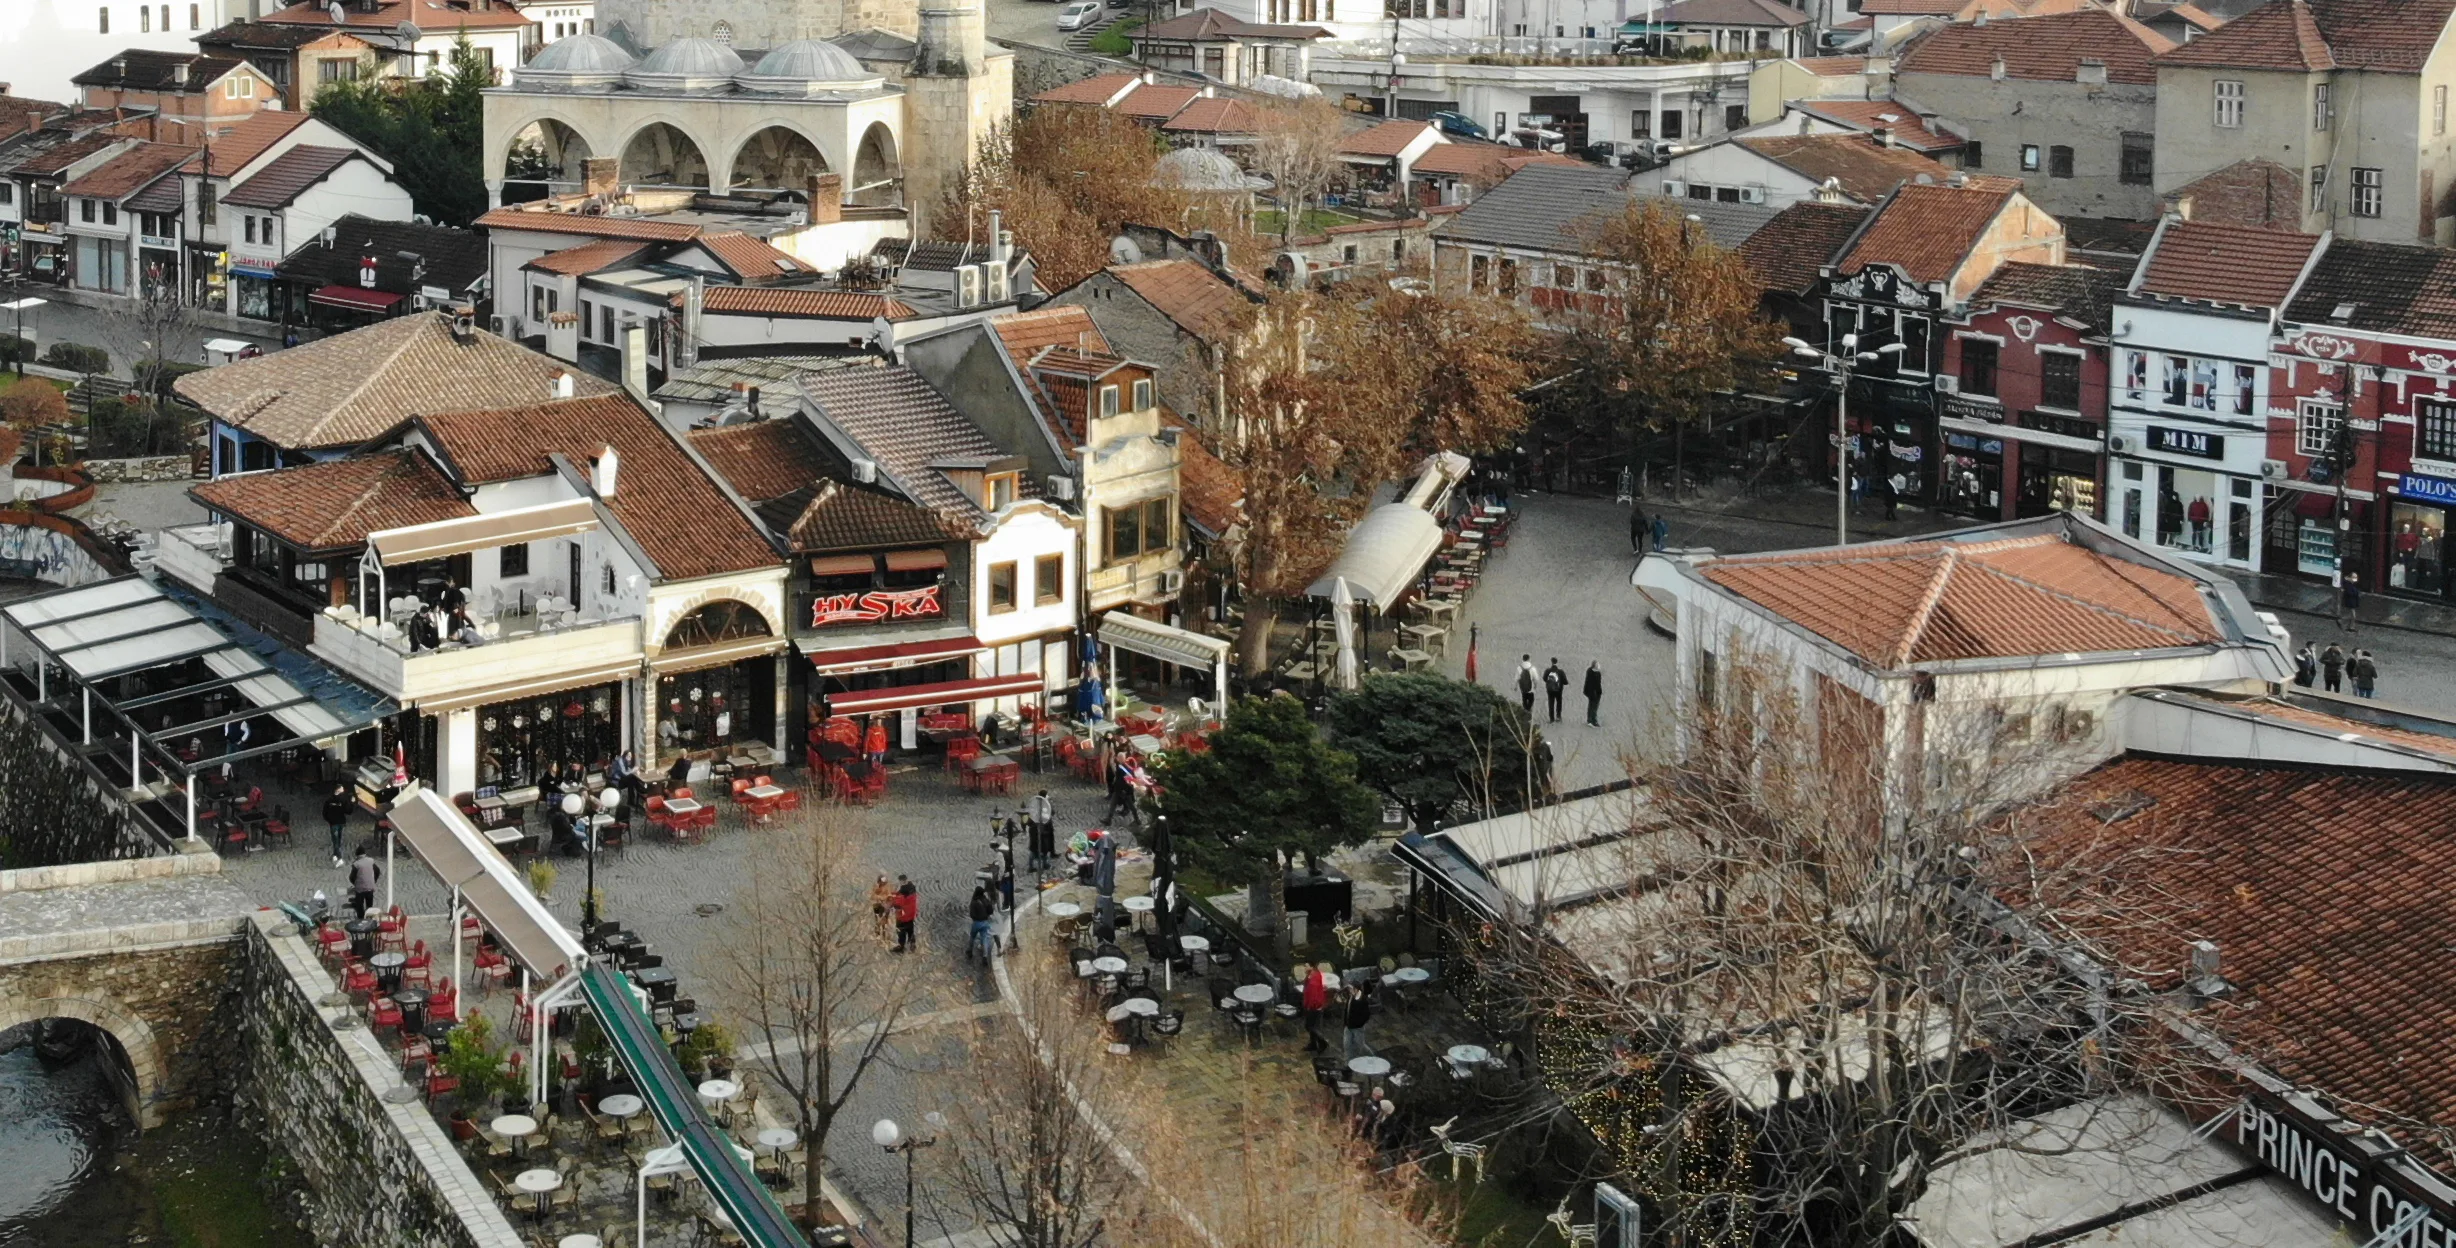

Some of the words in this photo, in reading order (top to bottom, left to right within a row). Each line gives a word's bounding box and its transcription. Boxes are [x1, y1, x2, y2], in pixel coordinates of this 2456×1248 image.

[545, 9, 581, 17] HOTEL
[2162, 431, 2207, 451] MIM
[812, 585, 940, 627] HYSKA
[2238, 1103, 2359, 1221] PRINCE
